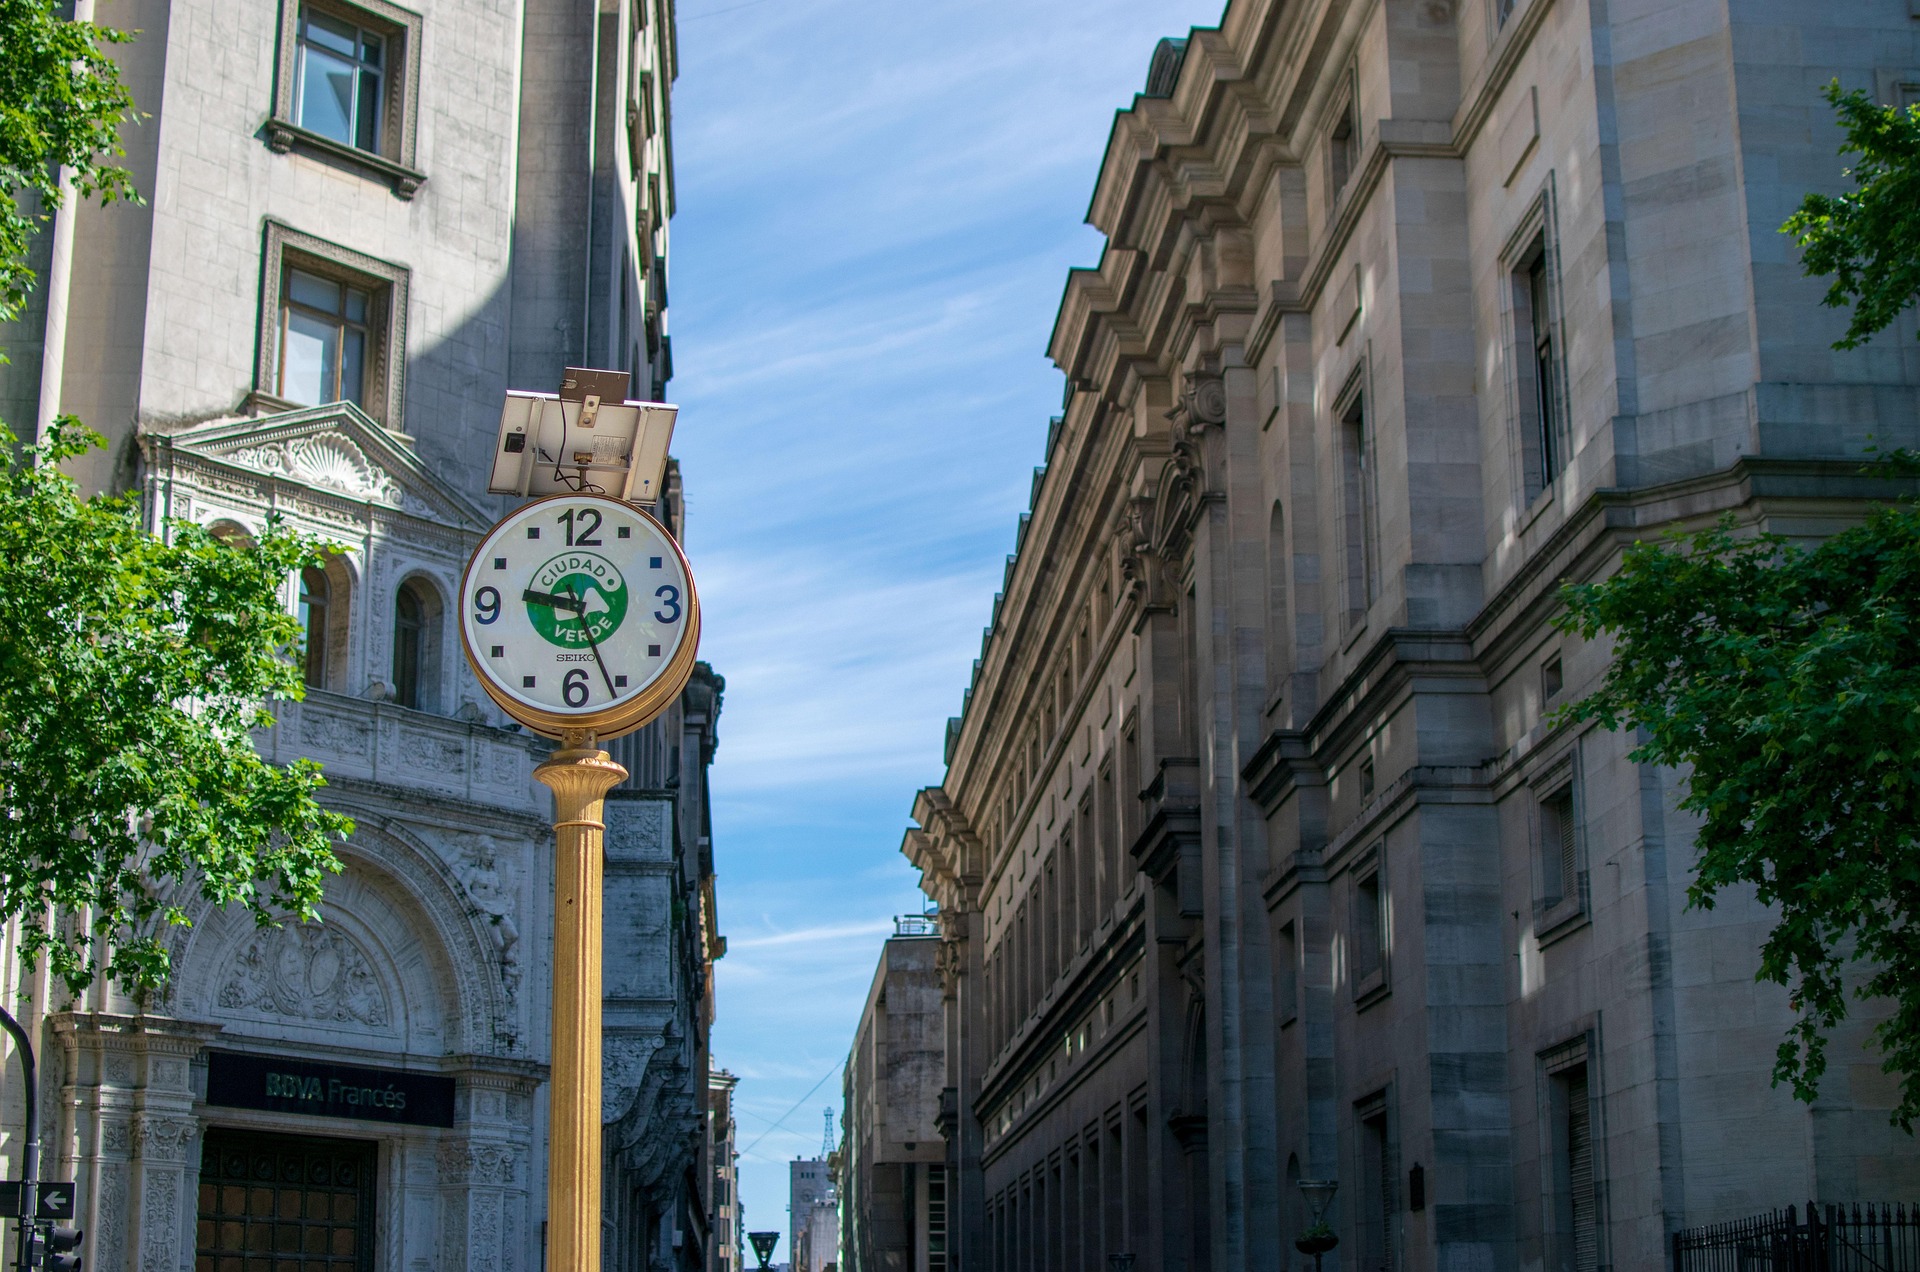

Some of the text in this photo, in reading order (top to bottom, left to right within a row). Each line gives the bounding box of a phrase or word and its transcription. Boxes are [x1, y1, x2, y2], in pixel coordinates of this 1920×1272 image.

[558, 508, 602, 546] 12
[541, 557, 606, 587] CIUDAD
[474, 586, 501, 625] 9
[654, 585, 680, 624] 3
[554, 616, 613, 642] VERDE
[556, 654, 596, 662] SEIKO
[562, 669, 589, 708] 6
[265, 1072, 406, 1109] BBVA Francés
